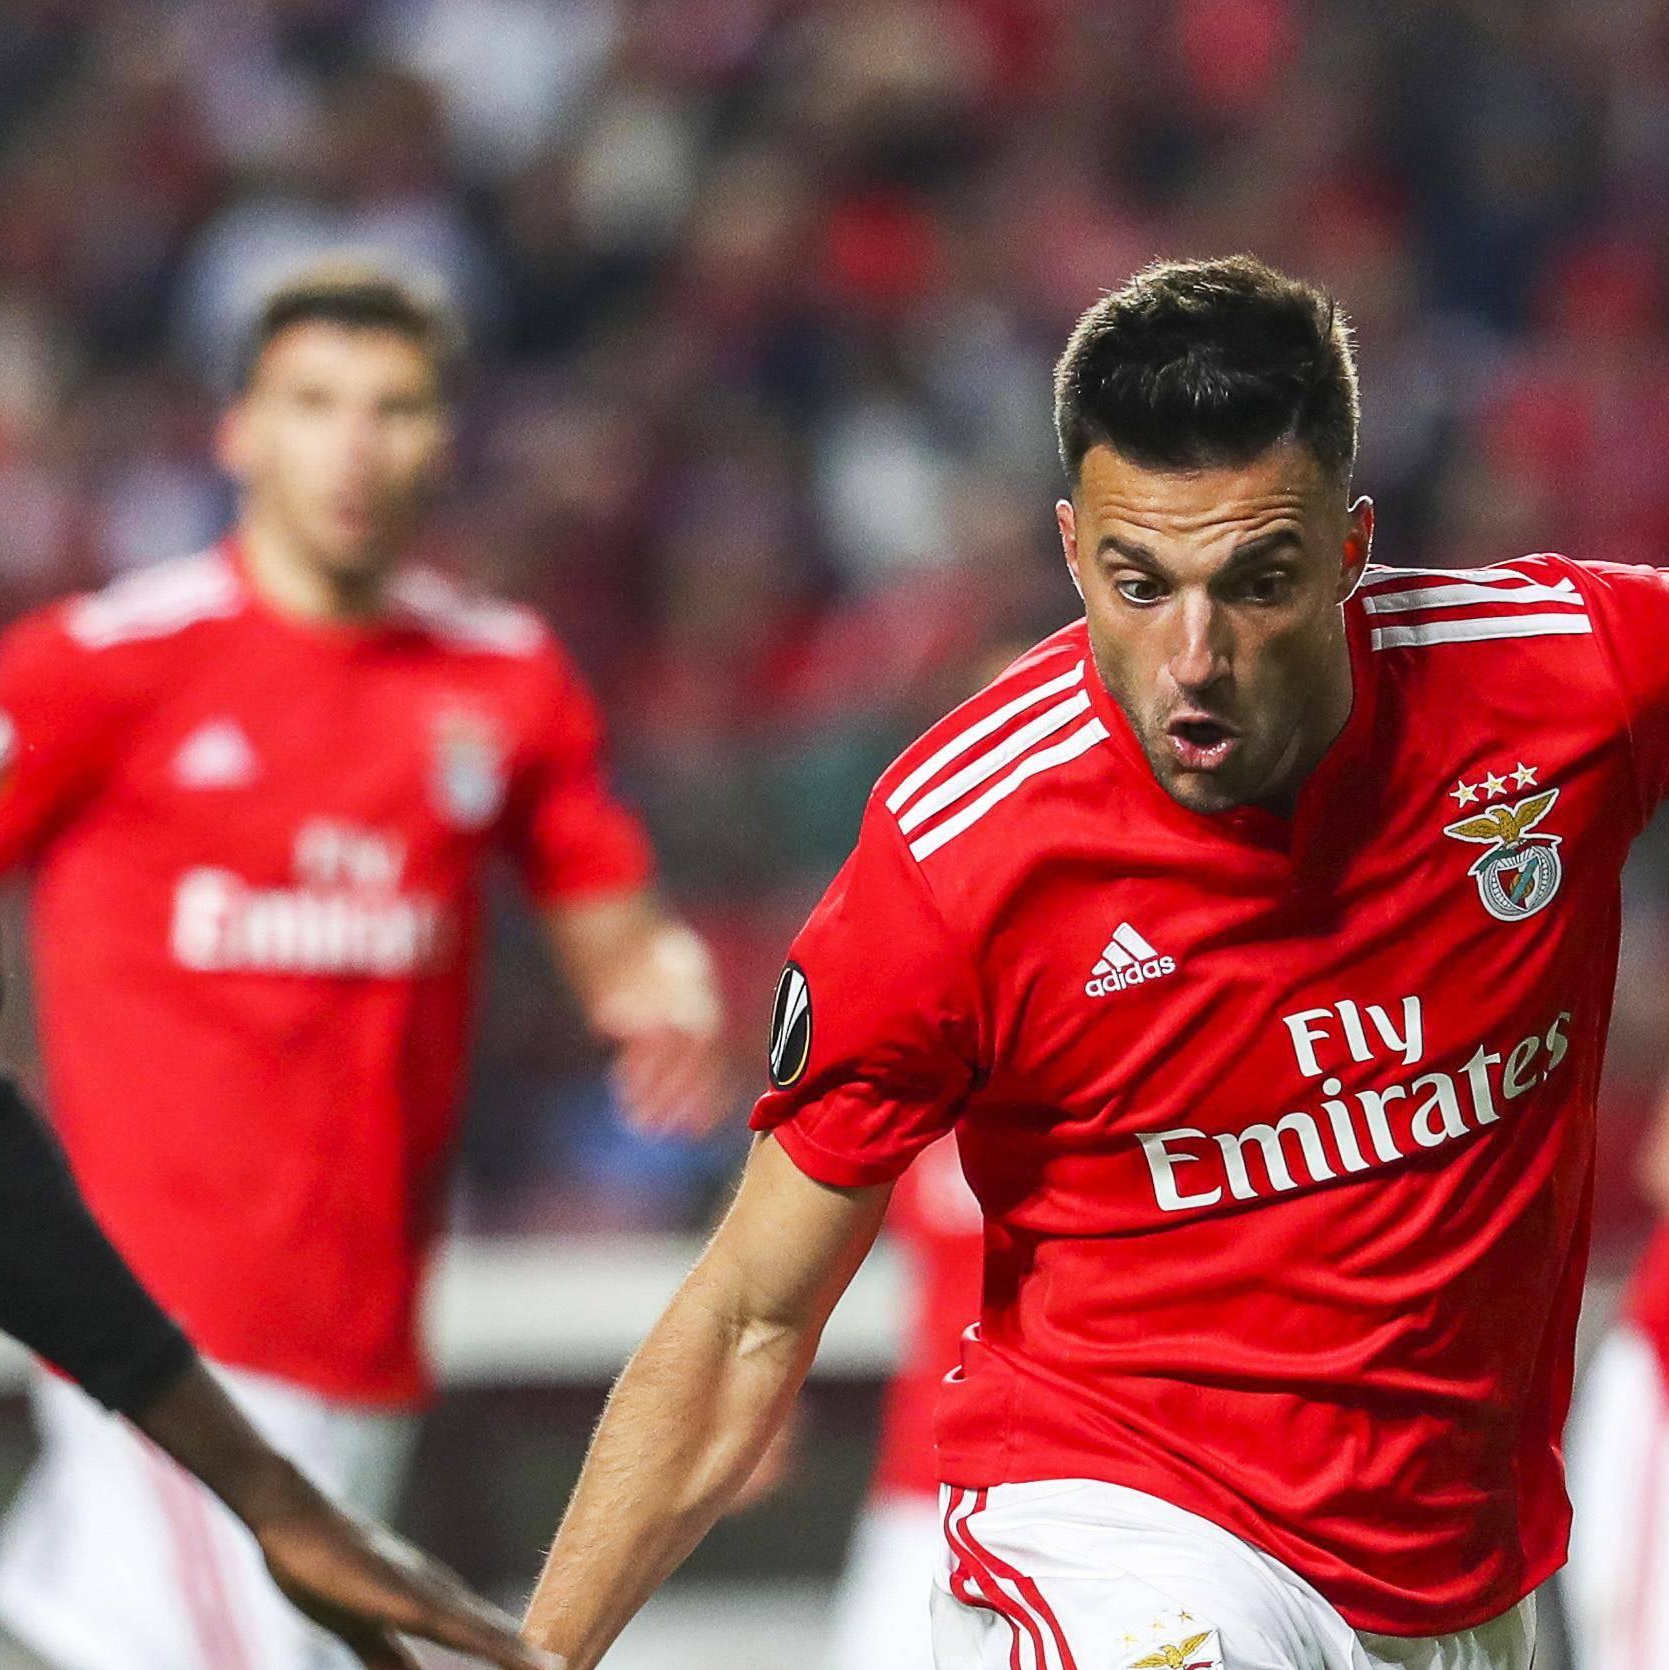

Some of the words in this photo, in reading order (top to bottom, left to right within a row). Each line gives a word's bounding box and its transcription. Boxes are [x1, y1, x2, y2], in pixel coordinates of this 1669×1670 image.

[1084, 955, 1177, 997] adidas
[1282, 995, 1424, 1078] Fly
[1136, 1011, 1572, 1213] Emirates
